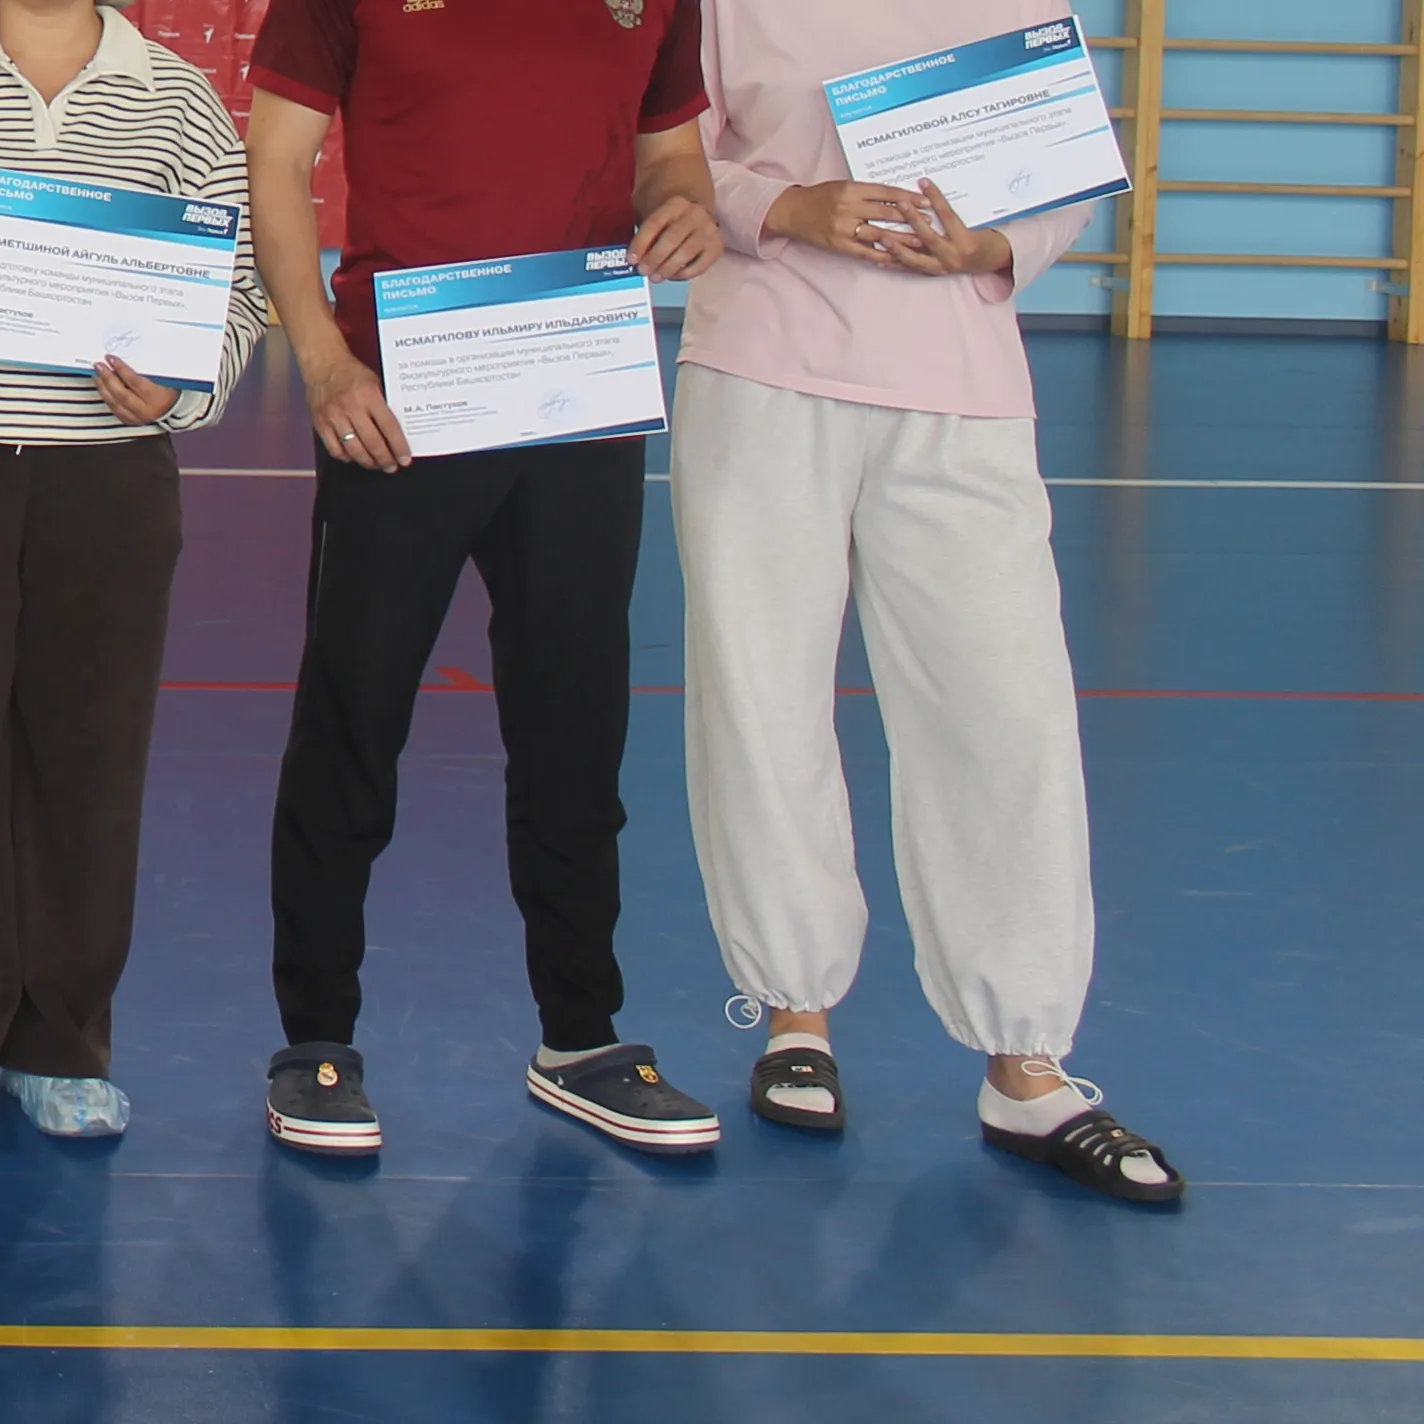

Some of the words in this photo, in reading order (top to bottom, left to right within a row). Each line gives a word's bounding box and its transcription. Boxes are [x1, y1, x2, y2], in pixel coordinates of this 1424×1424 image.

[402, 0, 445, 13] adidas
[1023, 22, 1066, 41] ВЫЗОВ
[1023, 26, 1072, 49] ПЕРВЫХ
[830, 53, 956, 96] БЛАГОДАРСТВЕННОЕ
[833, 84, 888, 106] ПИСЬМО
[855, 114, 949, 149] ИСМАГИЛОВОЙ
[948, 106, 981, 123] АЛСУ
[981, 88, 1051, 114] ТАГИРОВНЕ
[182, 211, 232, 228] ПЕРВЫХ
[185, 203, 228, 218] ВЫЗОВ
[71, 247, 118, 264] АЙГУЛЬ
[120, 256, 210, 279] АЛЬБЕРТОВНЕ
[584, 256, 629, 271] ПЕРВЫ
[585, 248, 627, 262] ВЫЗОВ
[380, 263, 512, 289] БЛАГОДАРСТВЕННОЕ
[382, 285, 437, 300] ПИСЬМО
[393, 329, 480, 348] ИСМАГИЛОВУ
[481, 321, 543, 337] ИЛЬМИРУ
[544, 310, 639, 330] ИЛЬДАРОВИЧУ
